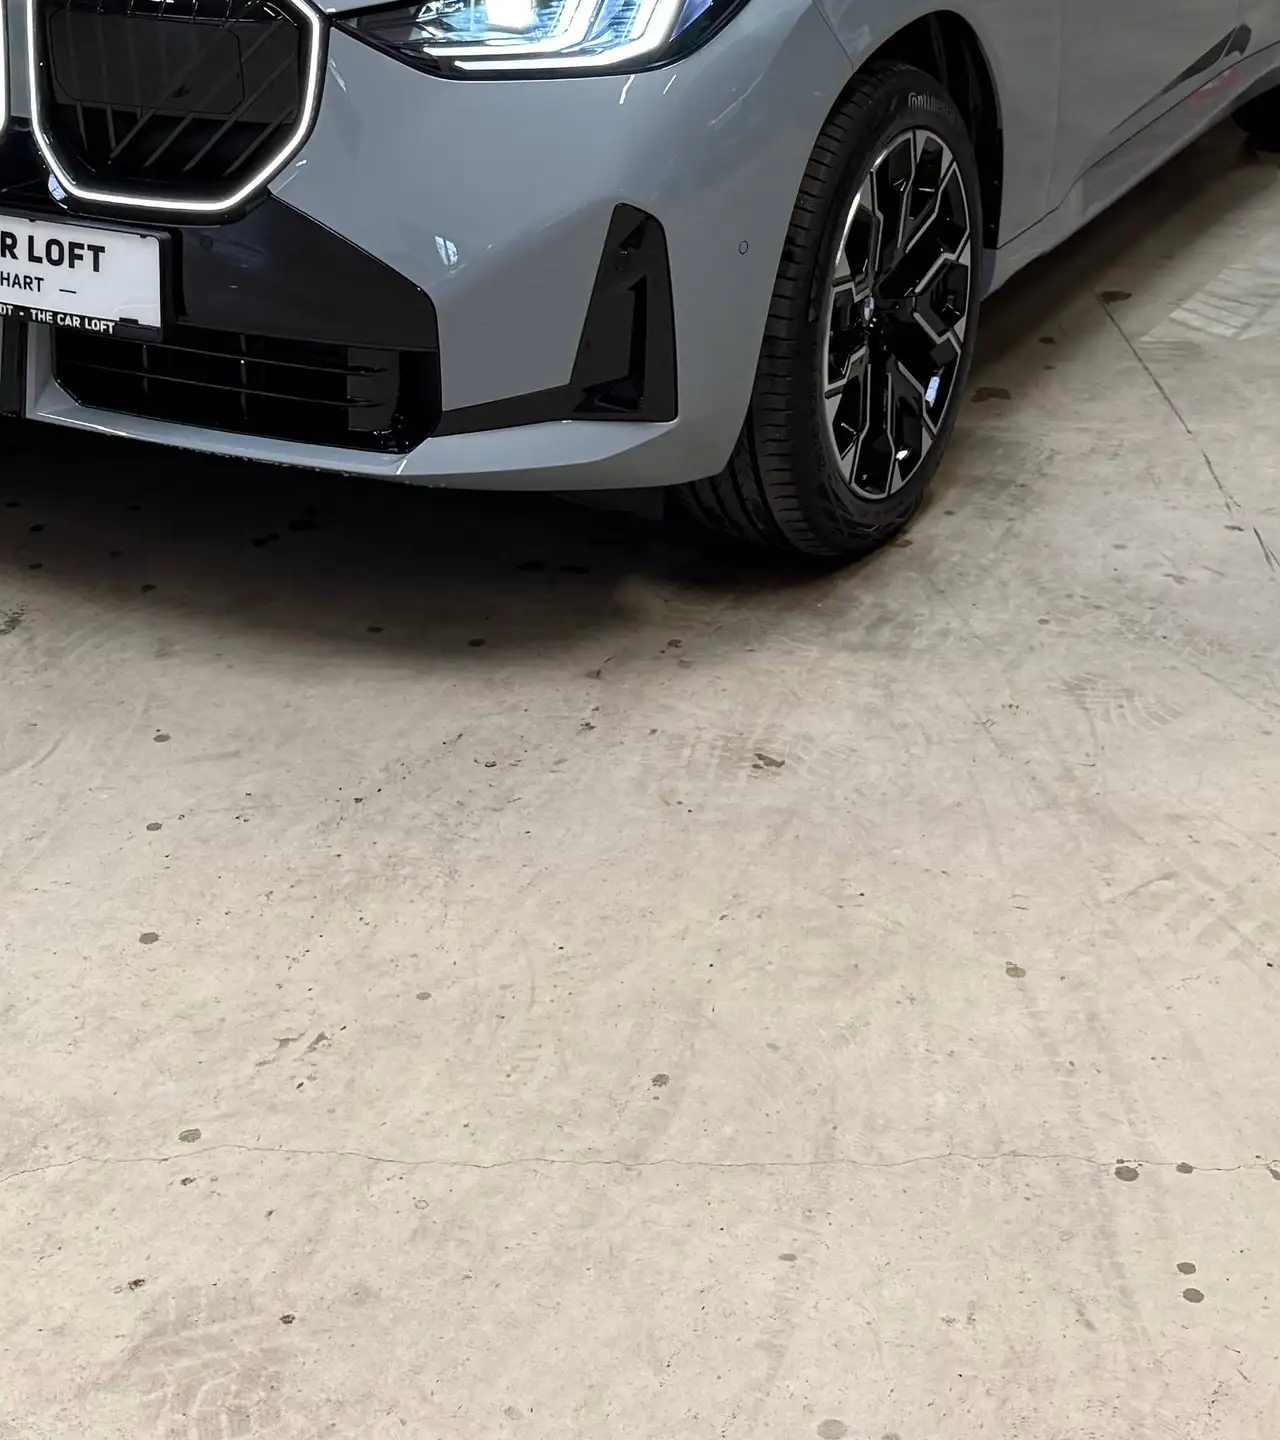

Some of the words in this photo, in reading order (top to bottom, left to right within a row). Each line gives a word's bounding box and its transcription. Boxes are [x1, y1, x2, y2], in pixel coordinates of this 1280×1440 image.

[27, 234, 107, 274] LOFT
[29, 308, 54, 324] THE
[56, 312, 81, 329] CAR
[84, 317, 116, 335] LOFT
